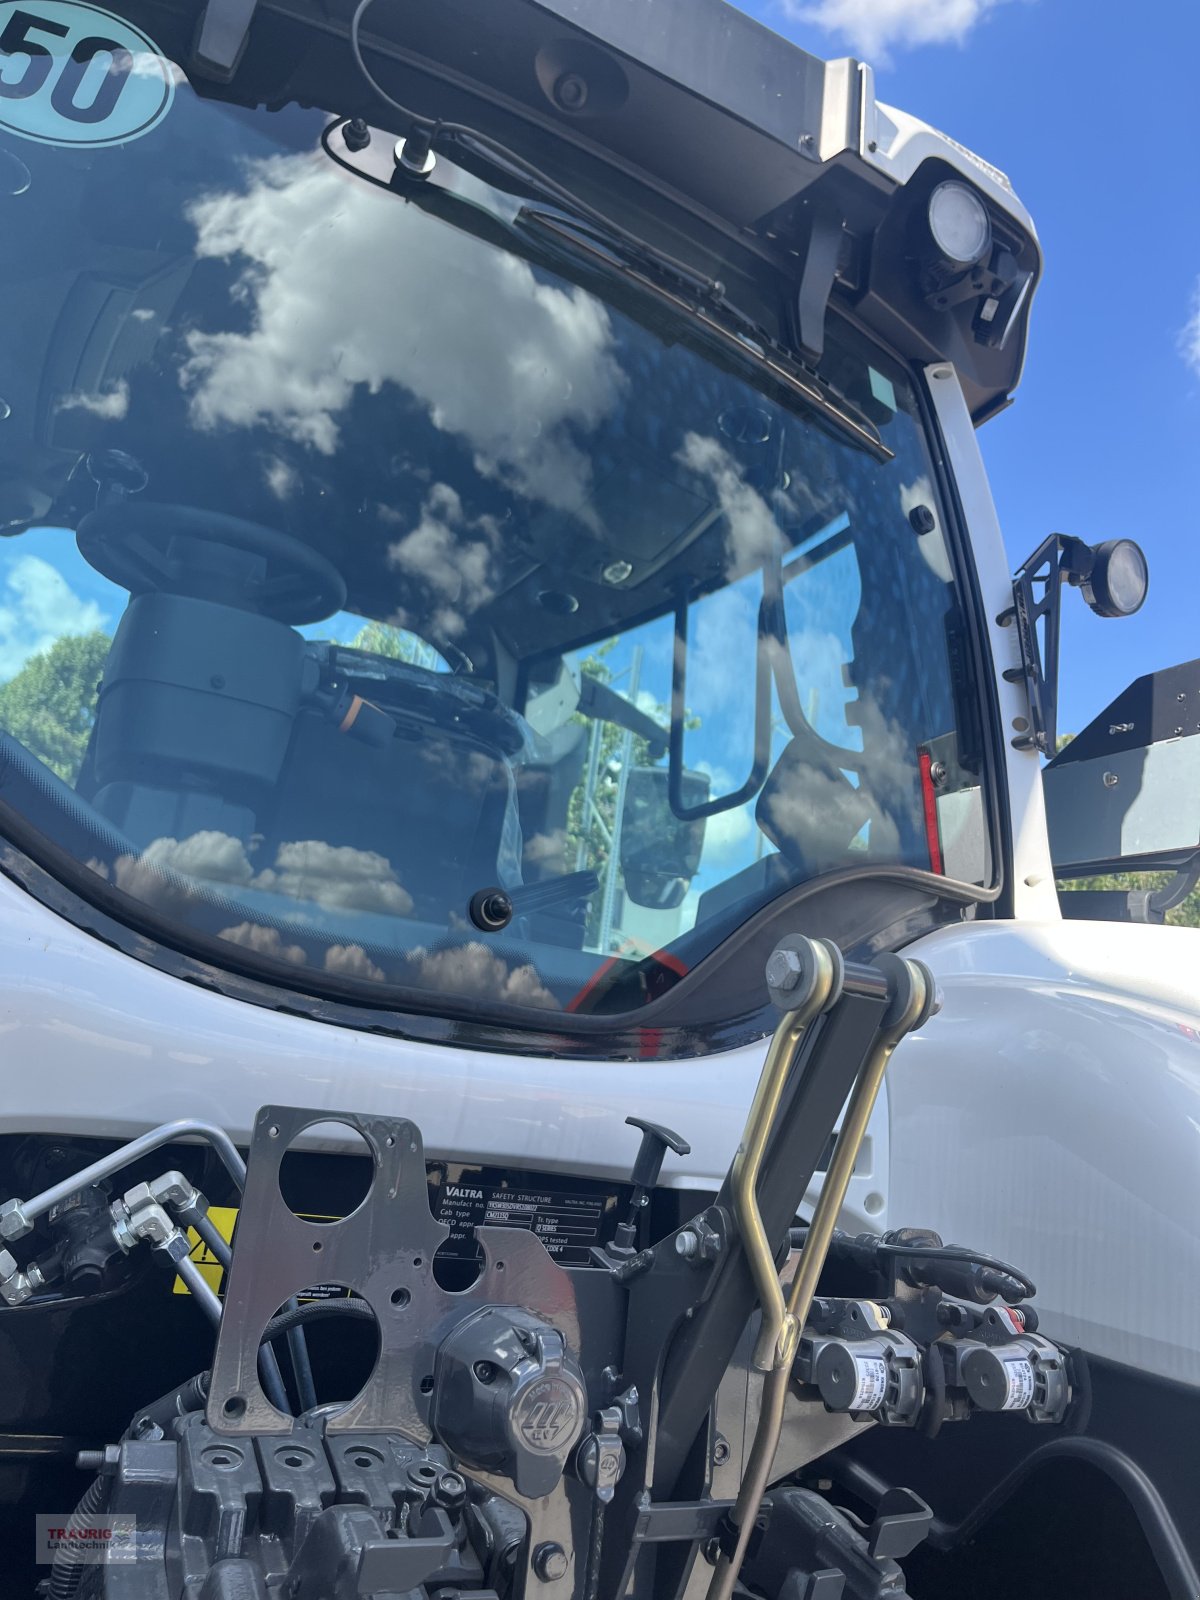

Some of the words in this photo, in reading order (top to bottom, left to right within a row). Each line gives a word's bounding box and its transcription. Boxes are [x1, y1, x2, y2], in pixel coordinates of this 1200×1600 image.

[0, 9, 133, 124] 50
[446, 1186, 483, 1199] VALTRA
[492, 1192, 515, 1201] SAFETY
[517, 1194, 552, 1204] STRUCTURE
[442, 1198, 472, 1207] Manufact
[440, 1208, 453, 1216] Cab
